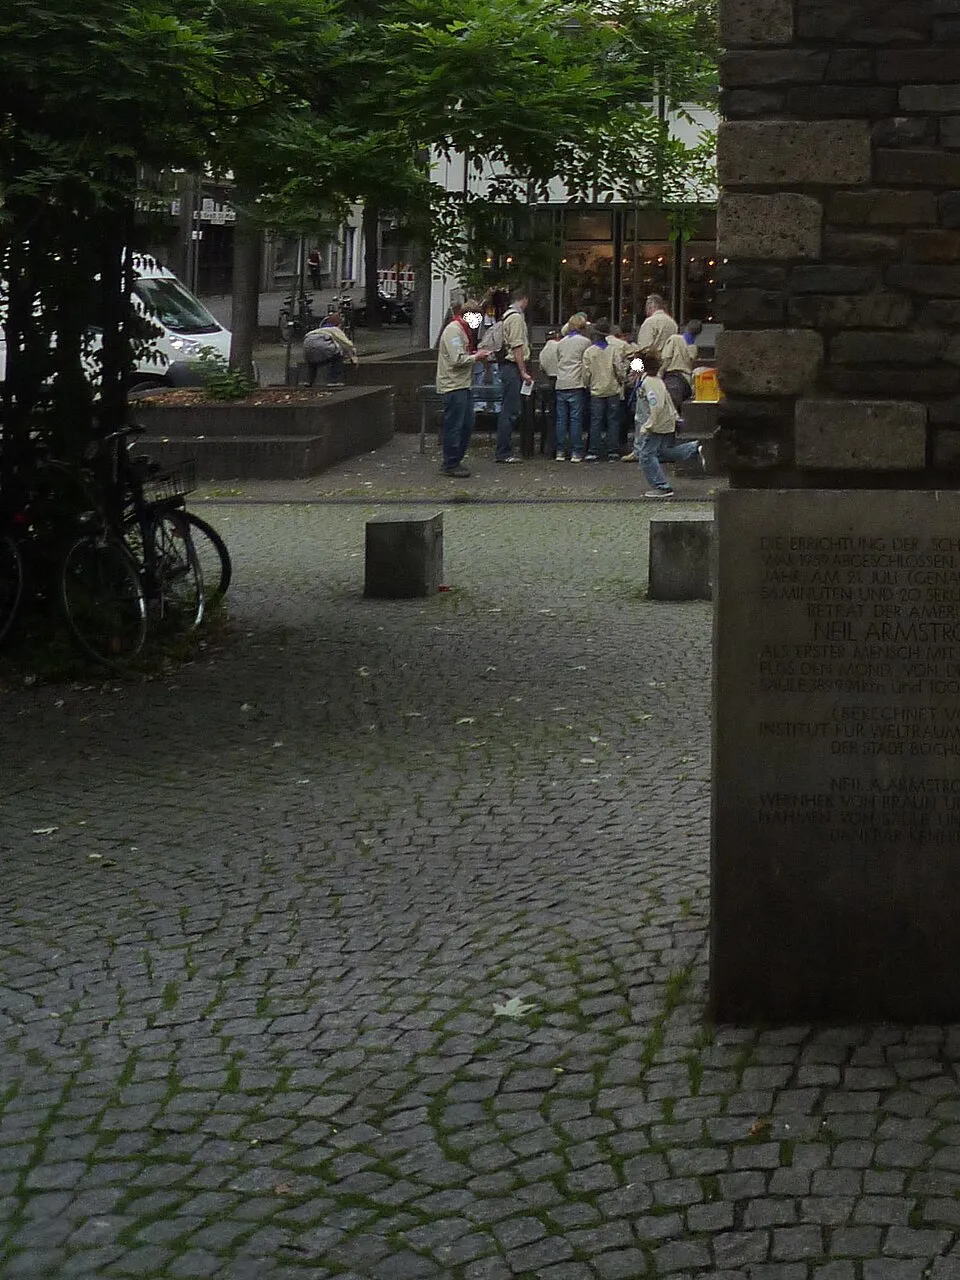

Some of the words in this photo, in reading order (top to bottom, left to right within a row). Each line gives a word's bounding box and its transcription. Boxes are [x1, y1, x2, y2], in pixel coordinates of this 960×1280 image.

[759, 536, 784, 551] DIE
[789, 536, 886, 551] ERRICHTUNG
[892, 536, 920, 552] DER
[810, 570, 840, 585] AM
[869, 570, 899, 586] JULI
[780, 586, 853, 601] MINUTEN
[858, 587, 895, 602] UND
[898, 588, 922, 603] 20
[806, 603, 865, 618] BETRAT
[873, 604, 902, 619] DER
[813, 621, 858, 642] NEIL
[760, 644, 789, 659] ALS
[793, 644, 847, 659] ERSTER
[853, 645, 920, 660] MENSCH
[925, 646, 955, 661] MIT
[800, 662, 833, 676] DEN
[902, 663, 939, 678] VON
[890, 679, 922, 695] und
[759, 721, 831, 738] INSTITUT
[830, 740, 859, 756] DER
[862, 740, 905, 756] STADT
[830, 777, 862, 792] NEIL
[759, 792, 834, 808] WERNHER
[840, 793, 876, 809] VON
